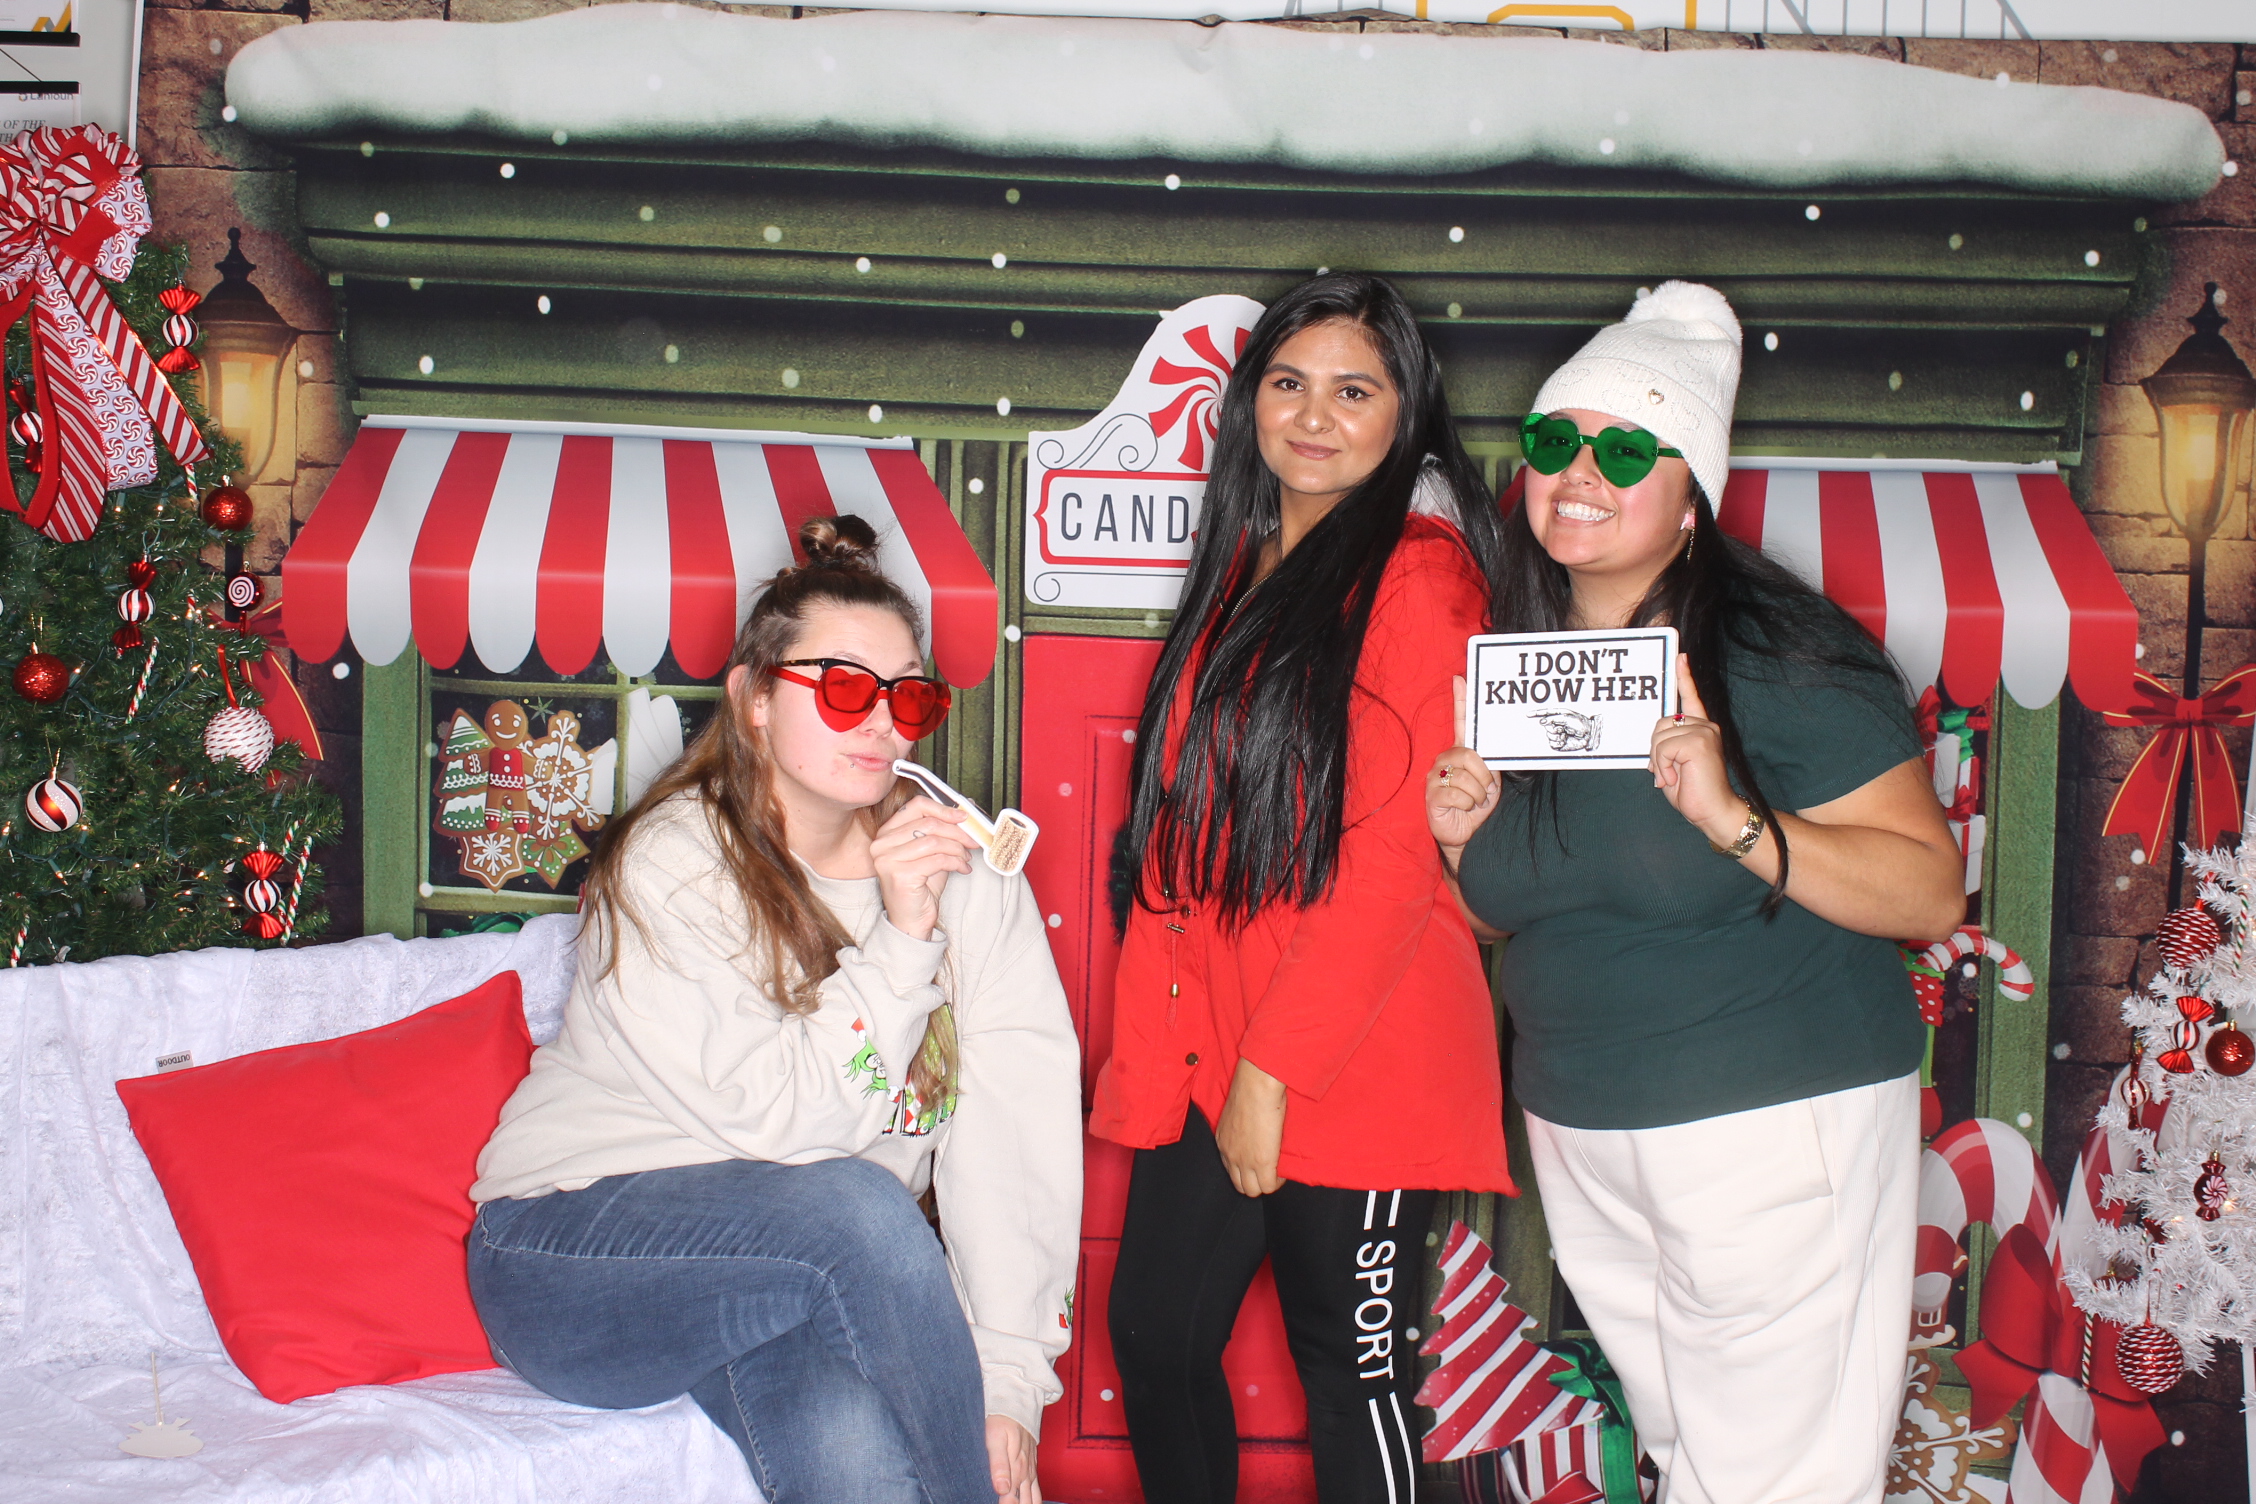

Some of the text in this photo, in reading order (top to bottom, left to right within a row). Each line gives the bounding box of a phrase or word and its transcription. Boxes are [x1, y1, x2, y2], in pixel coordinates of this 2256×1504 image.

[3, 120, 20, 130] OF
[1061, 492, 1190, 544] CAND
[1518, 648, 1629, 677] I DON'T
[1485, 675, 1659, 705] KNOW HER
[157, 1053, 191, 1068] OUTDOOR
[1354, 1239, 1397, 1380] SPORT
